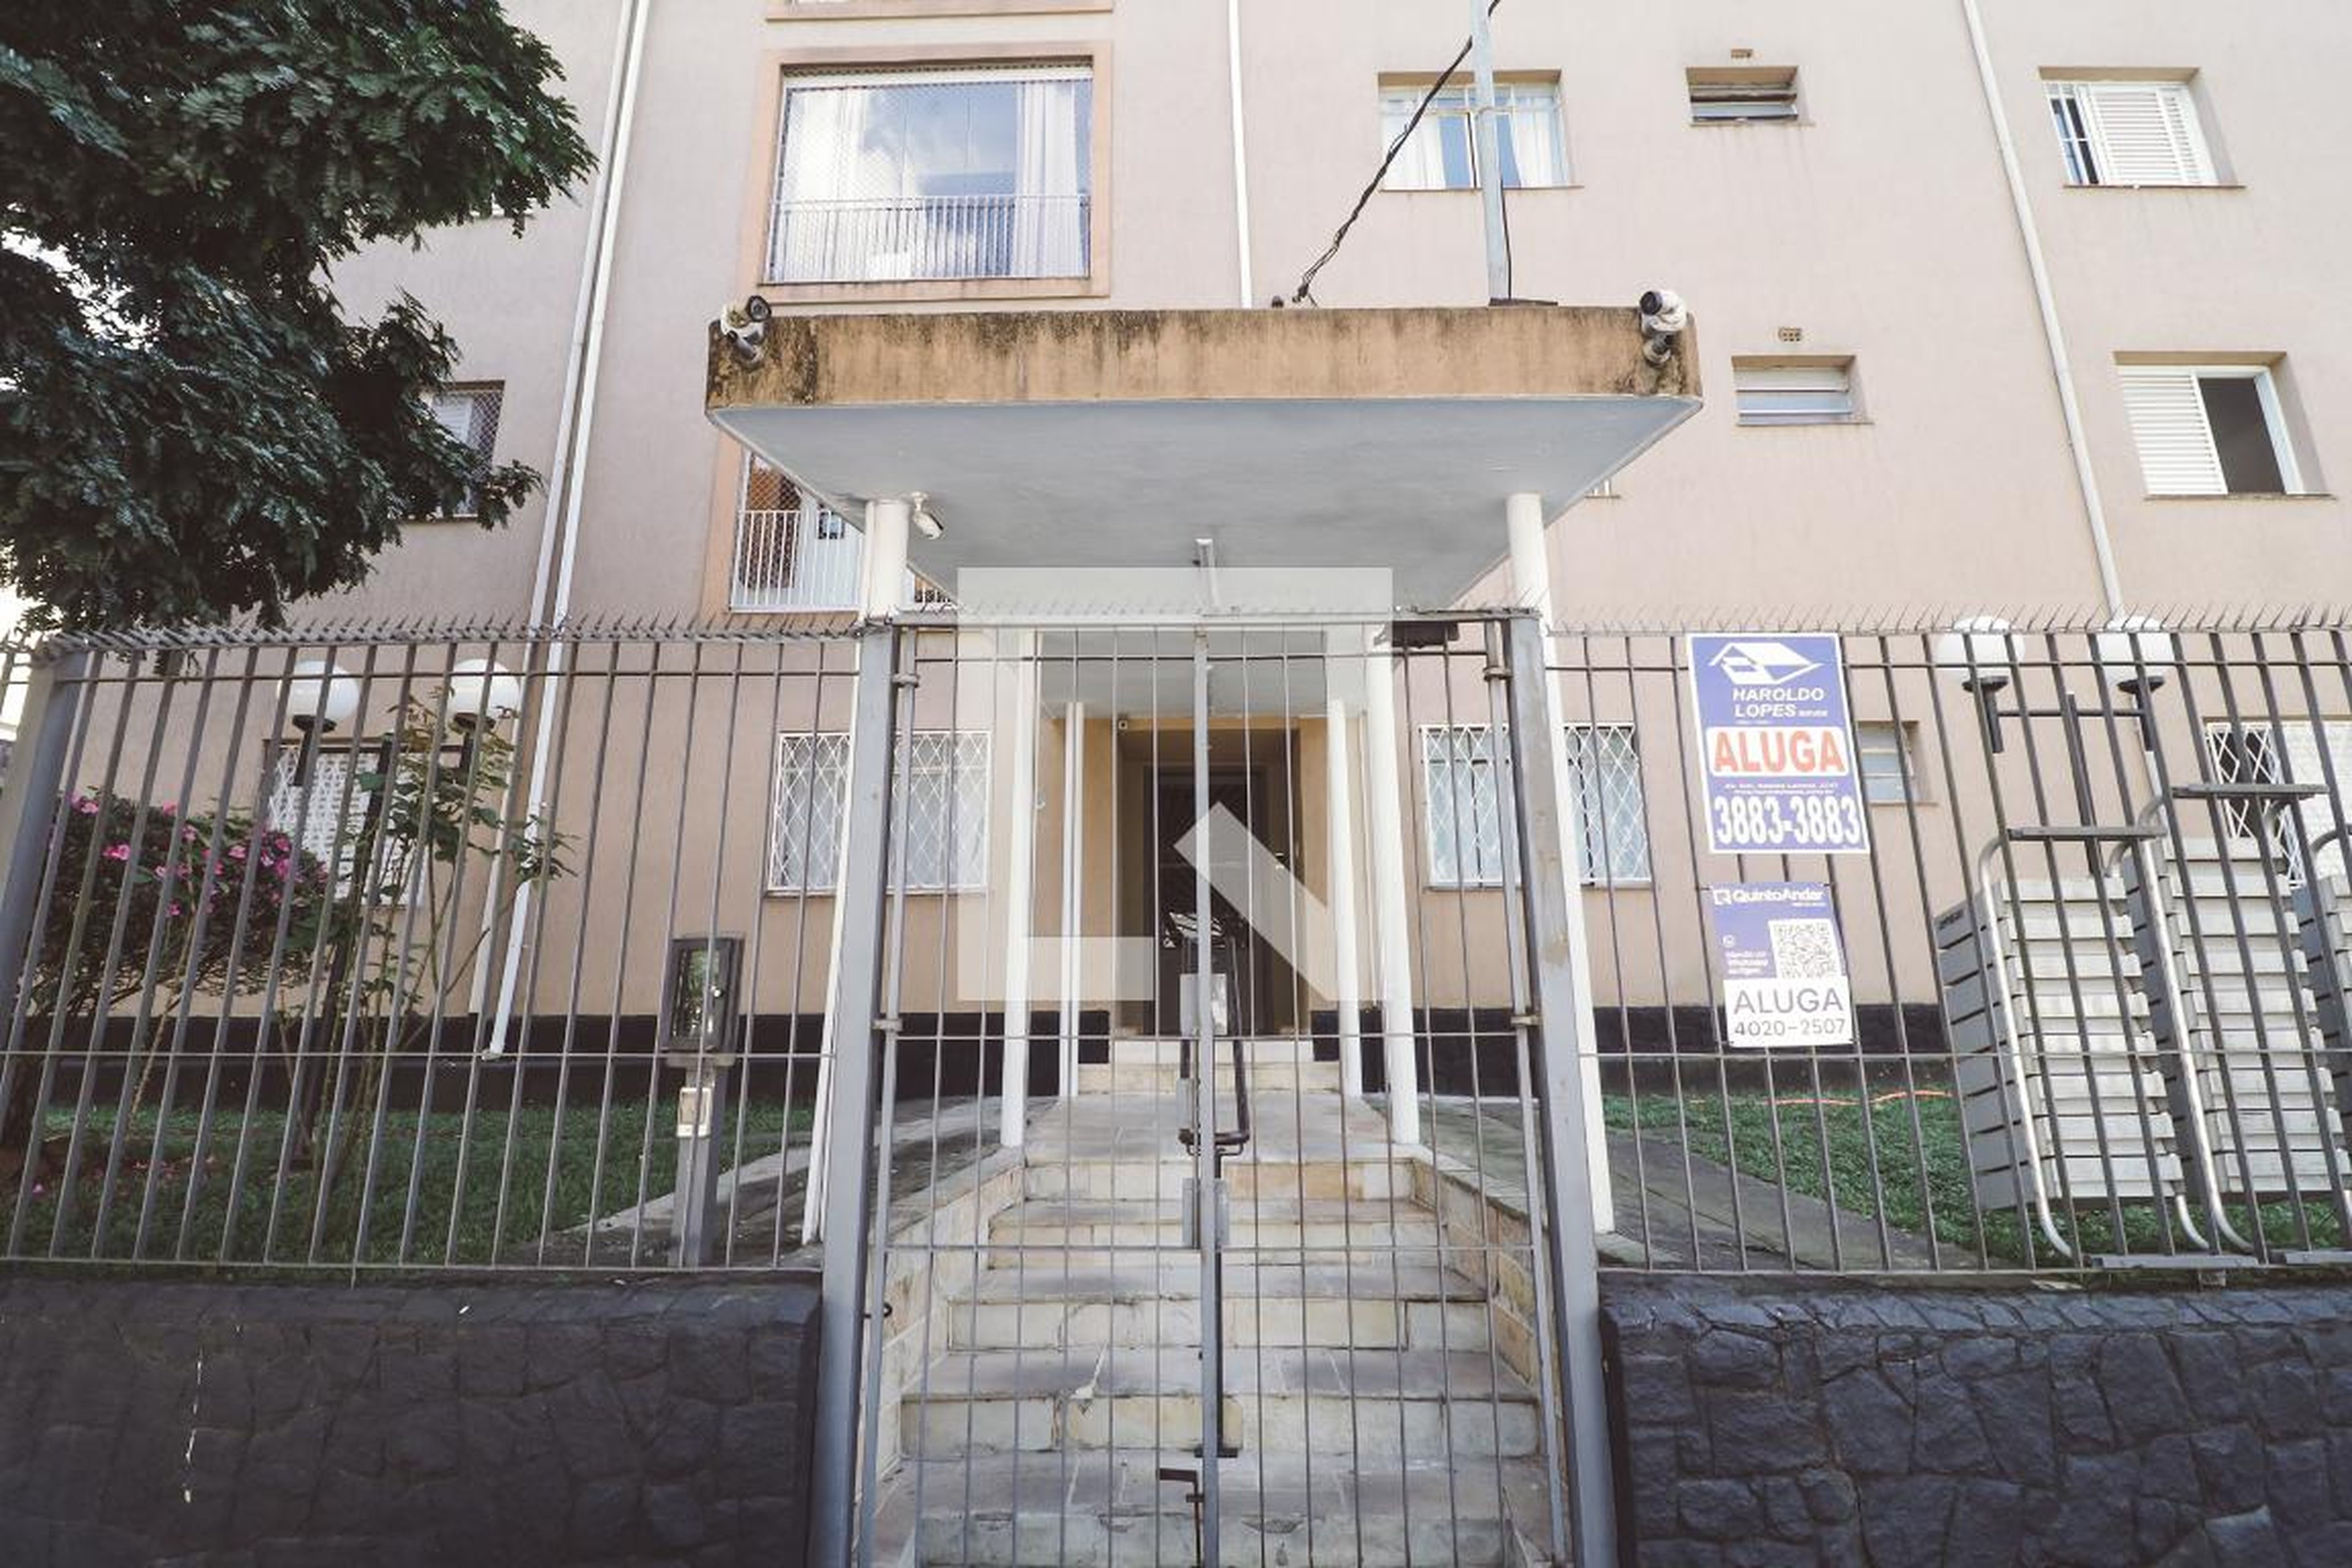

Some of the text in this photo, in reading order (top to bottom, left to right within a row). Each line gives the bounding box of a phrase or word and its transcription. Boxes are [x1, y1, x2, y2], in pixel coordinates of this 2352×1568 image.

[1733, 688, 1825, 701] HAROLDO
[1735, 704, 1797, 717] LOPES
[1714, 731, 1845, 772] ALUGA
[1715, 796, 1861, 843] 3883-3883
[1733, 888, 1824, 903] QuintoAndar
[1734, 988, 1843, 1015] ALUGA
[1735, 1018, 1845, 1036] 4020-2507
